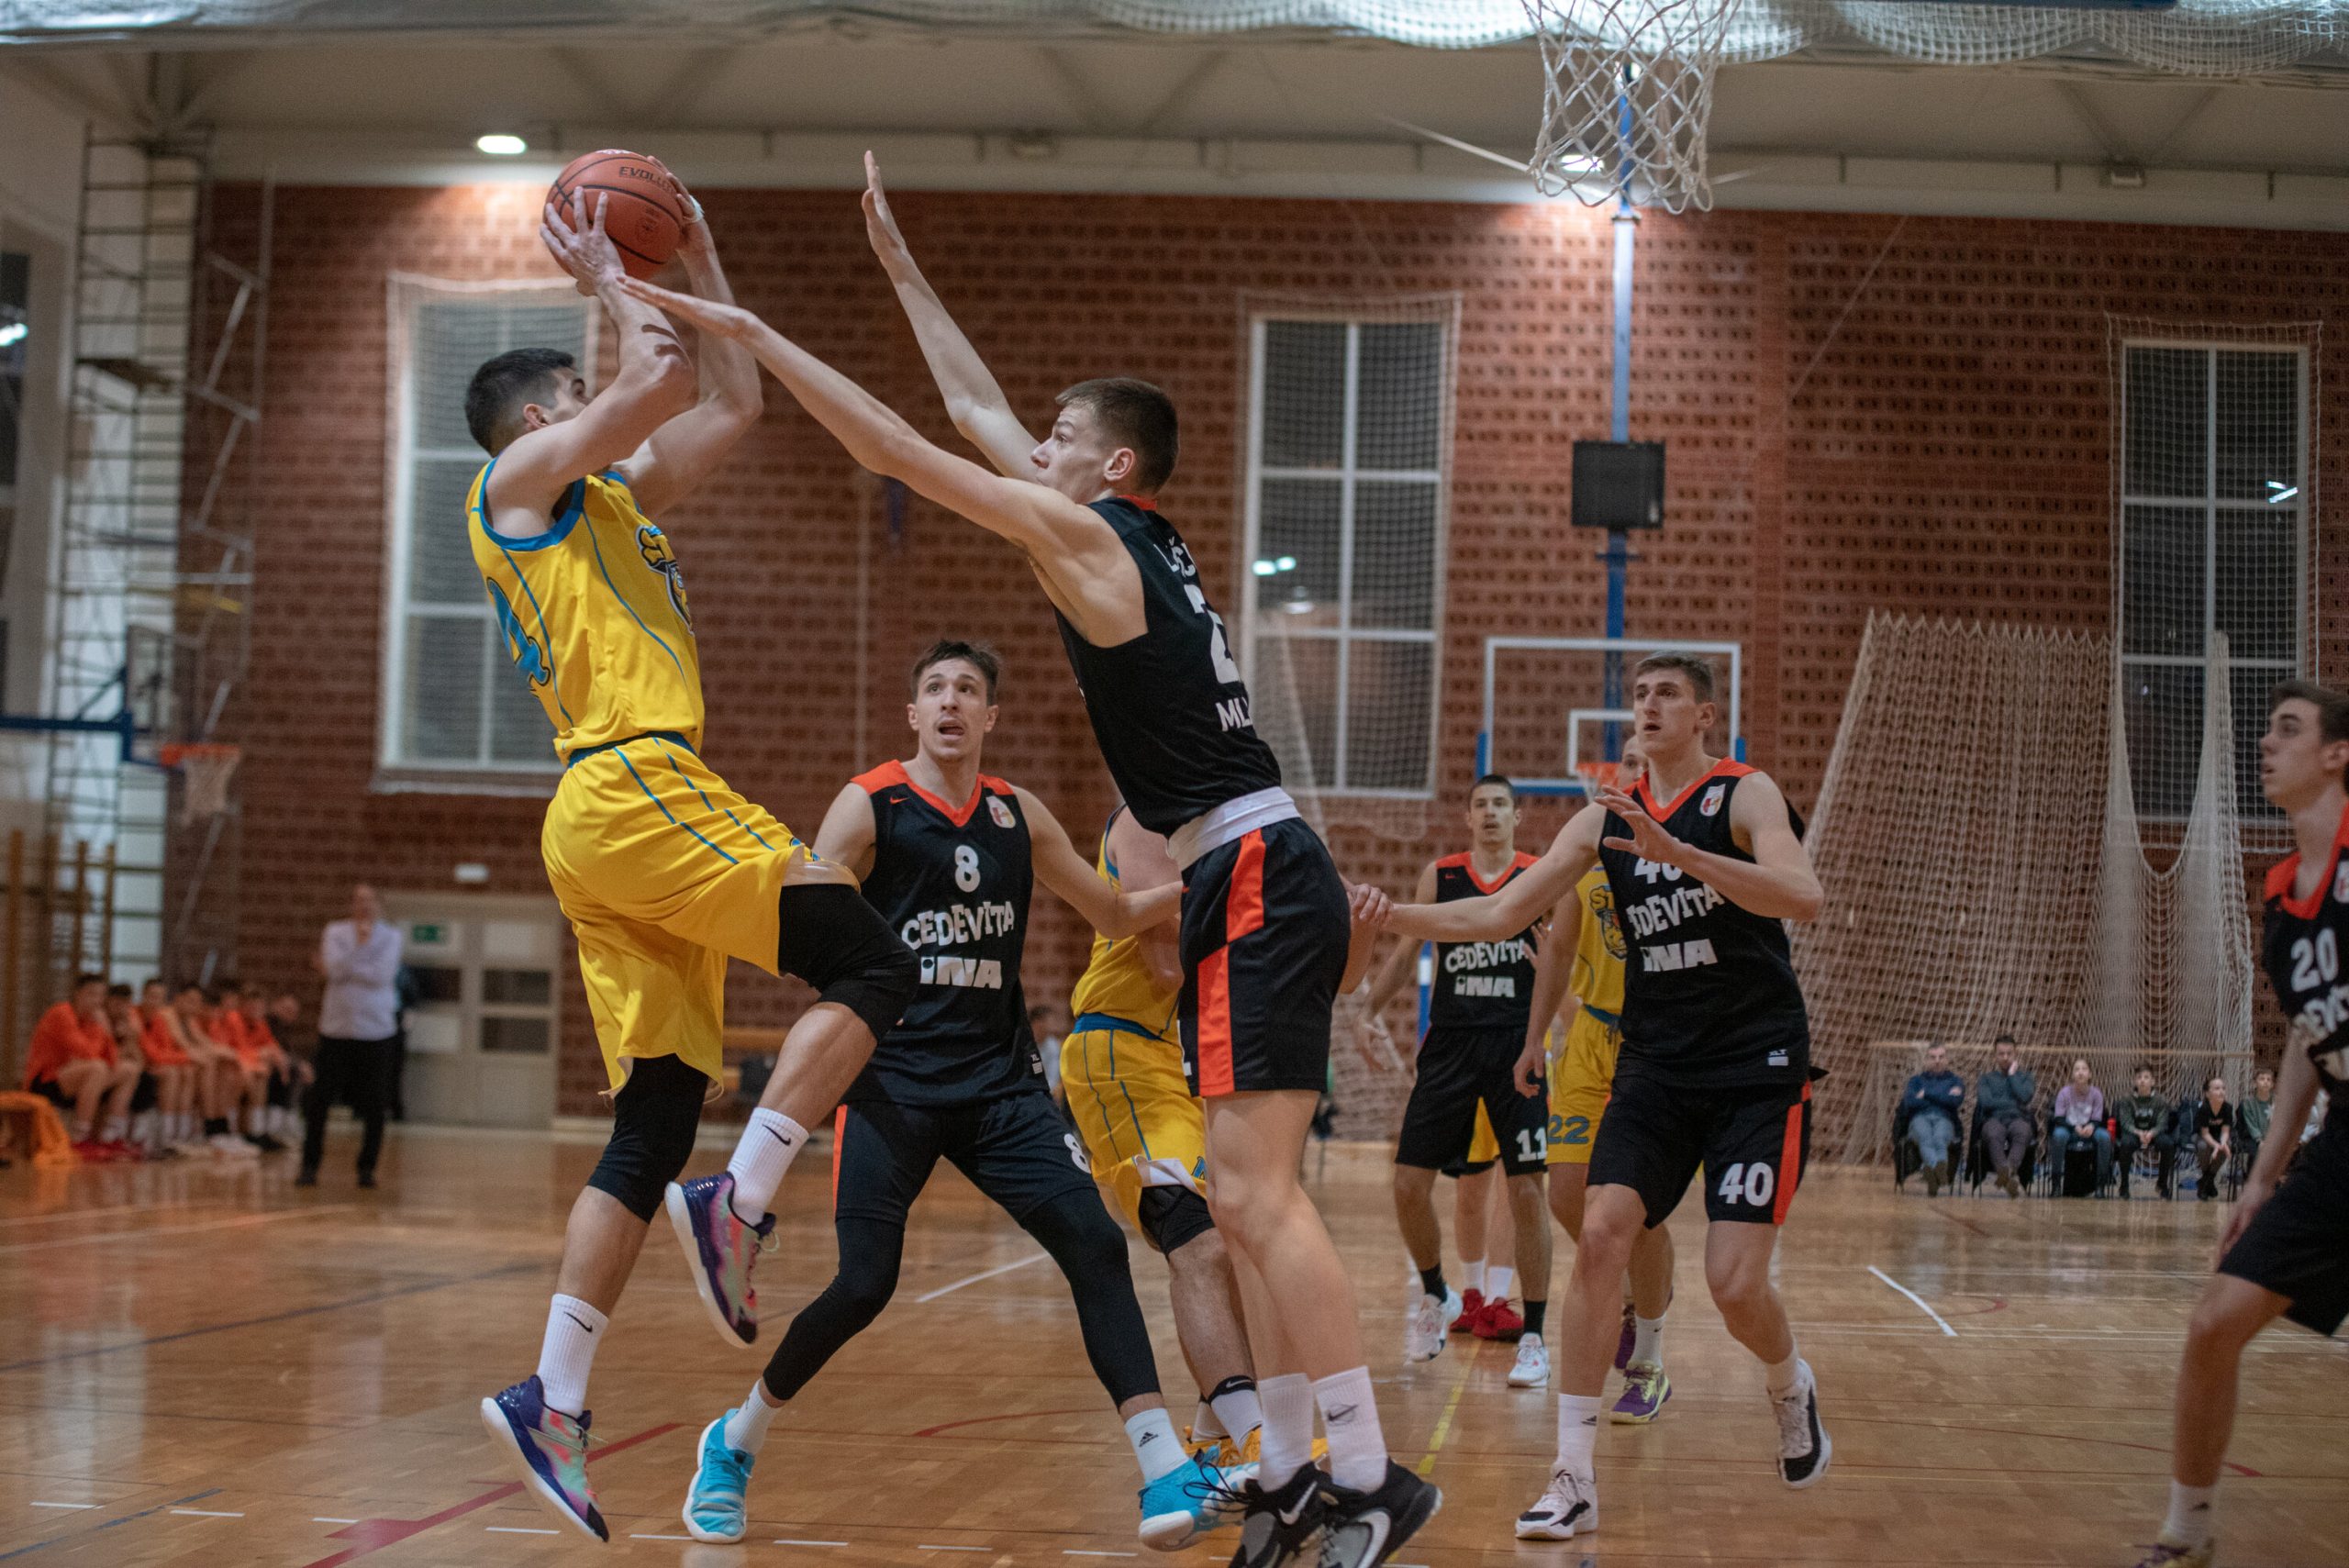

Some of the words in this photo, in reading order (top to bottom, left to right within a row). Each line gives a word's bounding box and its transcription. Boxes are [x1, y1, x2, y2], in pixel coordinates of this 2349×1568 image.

[1216, 696, 1253, 731] ML
[955, 845, 981, 893] 8
[901, 901, 1015, 951] CEDEVITA
[2291, 928, 2339, 992] 20
[1063, 1133, 1092, 1173] 8
[1516, 1127, 1548, 1162] 11
[1718, 1162, 1775, 1207] 40
